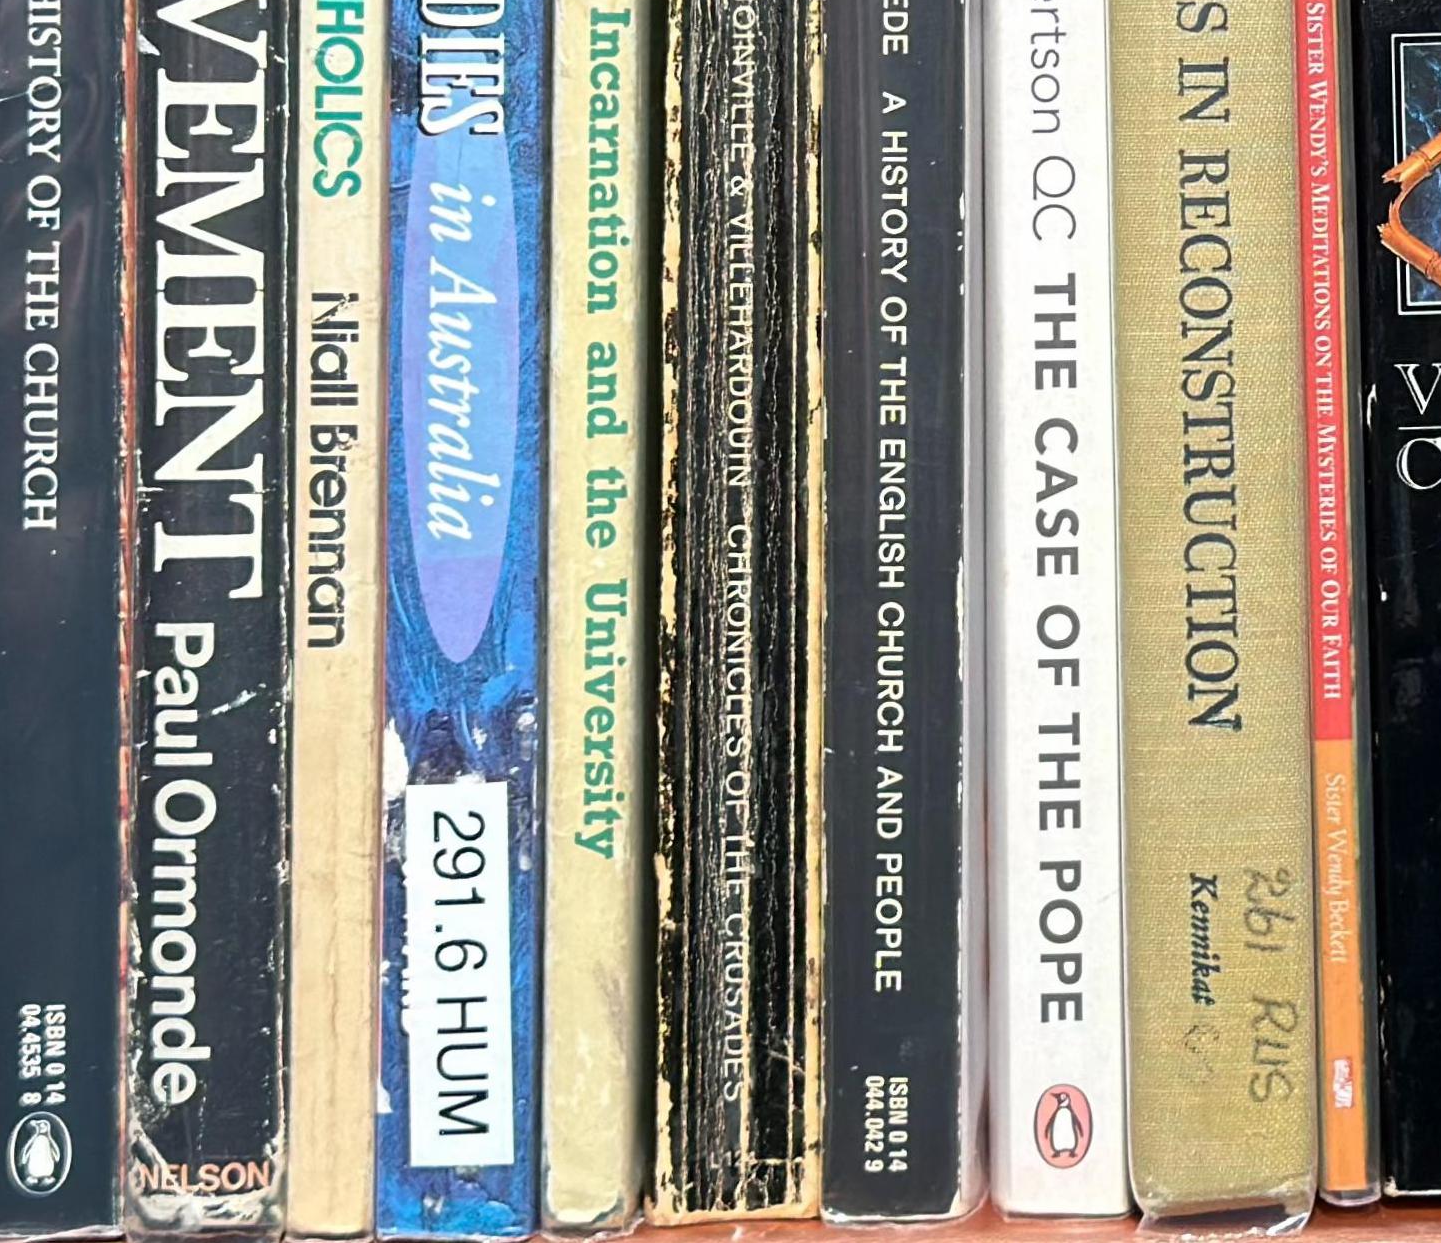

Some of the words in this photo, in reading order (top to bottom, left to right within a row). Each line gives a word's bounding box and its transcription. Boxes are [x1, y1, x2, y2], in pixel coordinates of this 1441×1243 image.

[1177, 56, 1230, 125] IN
[1306, 2, 1327, 75] SISTER
[882, 91, 907, 114] A
[23, 174, 61, 230] OF
[429, 181, 495, 242] in
[587, 8, 631, 314] Incarnation
[880, 130, 909, 283] HISTORY
[1032, 154, 1077, 241] QC
[23, 241, 60, 331] THE
[1311, 184, 1332, 331] MEDITATIONS
[310, 292, 359, 407] Niall
[880, 295, 908, 345] OF
[1033, 272, 1077, 391] THE
[1314, 335, 1333, 365] ON
[21, 343, 60, 530] CHURCH
[427, 256, 501, 541] Australia
[586, 341, 627, 439] and
[879, 357, 907, 426] THE
[1179, 147, 1242, 732] RECONSTRUCTION
[1315, 373, 1334, 416] THE
[307, 423, 359, 648] Brennan
[585, 466, 627, 549] the
[878, 439, 906, 588] ENGLISH
[1034, 417, 1079, 578] CASE
[1316, 424, 1338, 541] MYSTERIES
[1320, 550, 1339, 576] OF
[1321, 582, 1339, 627] OUR
[153, 622, 214, 767] Paul
[877, 601, 906, 753] CHURCH
[1036, 603, 1081, 687] OF
[1322, 634, 1342, 699] FAITH
[574, 578, 627, 859] University
[1038, 712, 1081, 831] THE
[876, 766, 903, 840] AND
[1324, 773, 1346, 826] Sister
[433, 811, 487, 973] 291.6
[1243, 867, 1294, 951] 261
[1324, 832, 1349, 896] Wendy
[151, 778, 217, 1105] Ormonde
[875, 853, 903, 992] PEOPLE
[1038, 858, 1084, 1024] POPE
[1189, 873, 1221, 1007] Kennikat
[1327, 899, 1350, 964] Beckett
[436, 996, 490, 1137] HUM
[1248, 998, 1300, 1105] RUS
